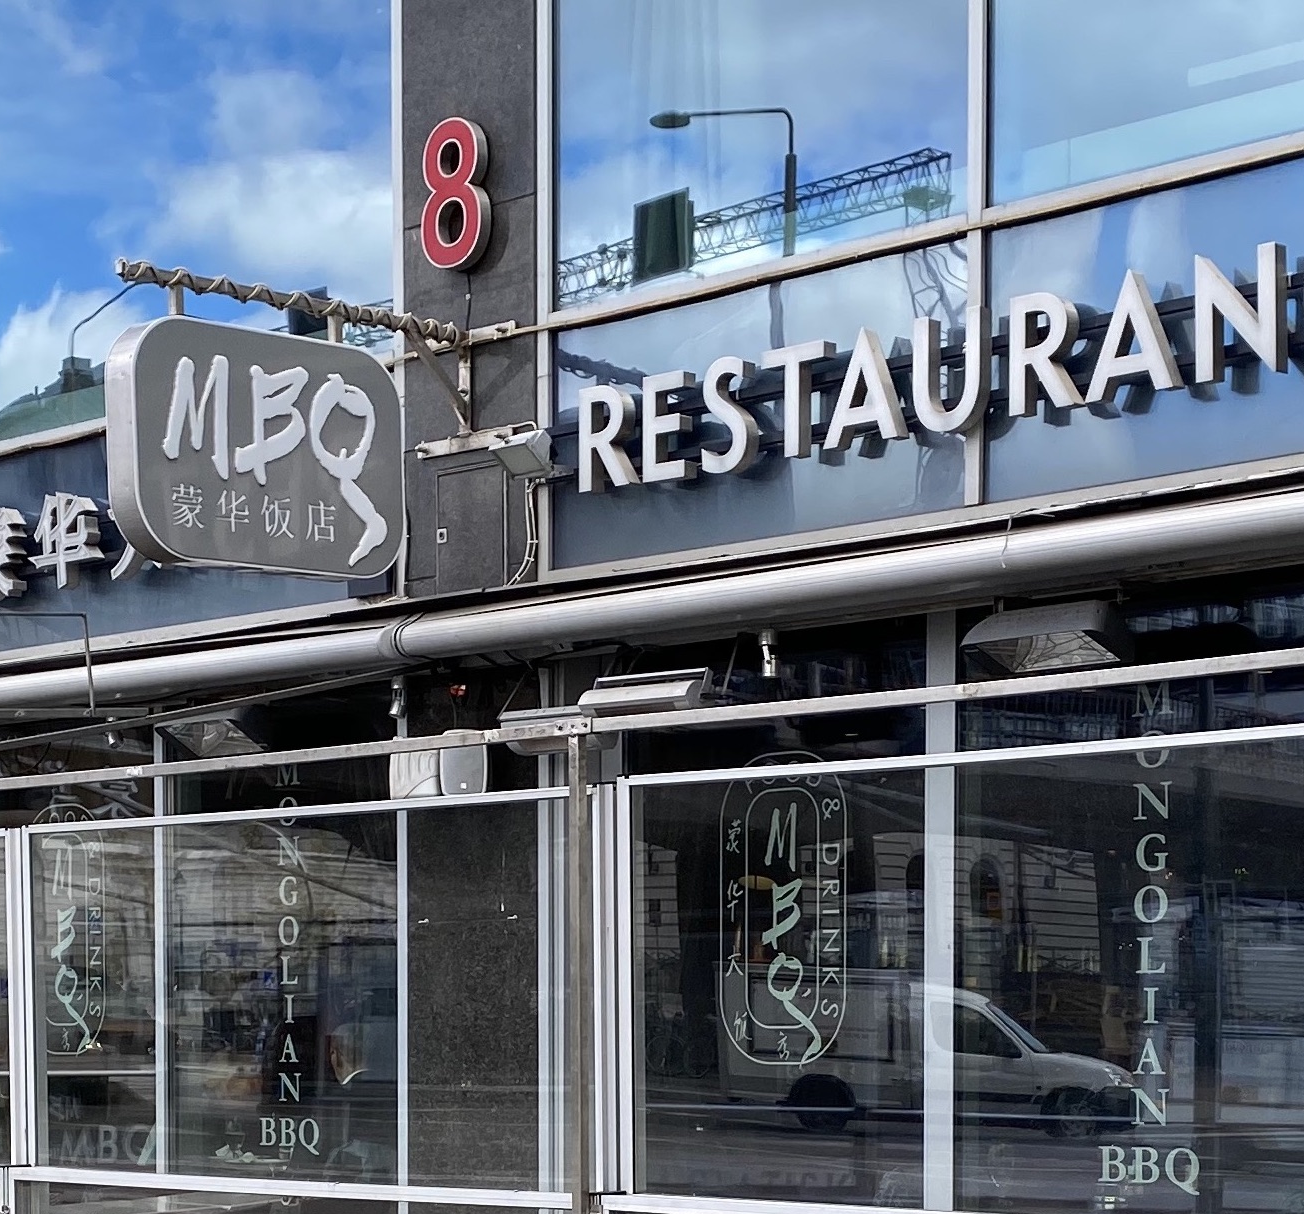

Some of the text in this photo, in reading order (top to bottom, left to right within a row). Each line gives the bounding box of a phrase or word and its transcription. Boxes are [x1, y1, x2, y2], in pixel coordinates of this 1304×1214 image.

[422, 116, 489, 270] 8
[162, 354, 388, 567] MBQ
[171, 483, 337, 543] 蒙华饭店
[275, 764, 301, 1102] MONGOLIAN
[821, 842, 841, 1018] DRINKS
[1131, 682, 1174, 1127] MONGOLIAN
[259, 1116, 320, 1156] BBQ
[1098, 1145, 1200, 1196] BBQ
